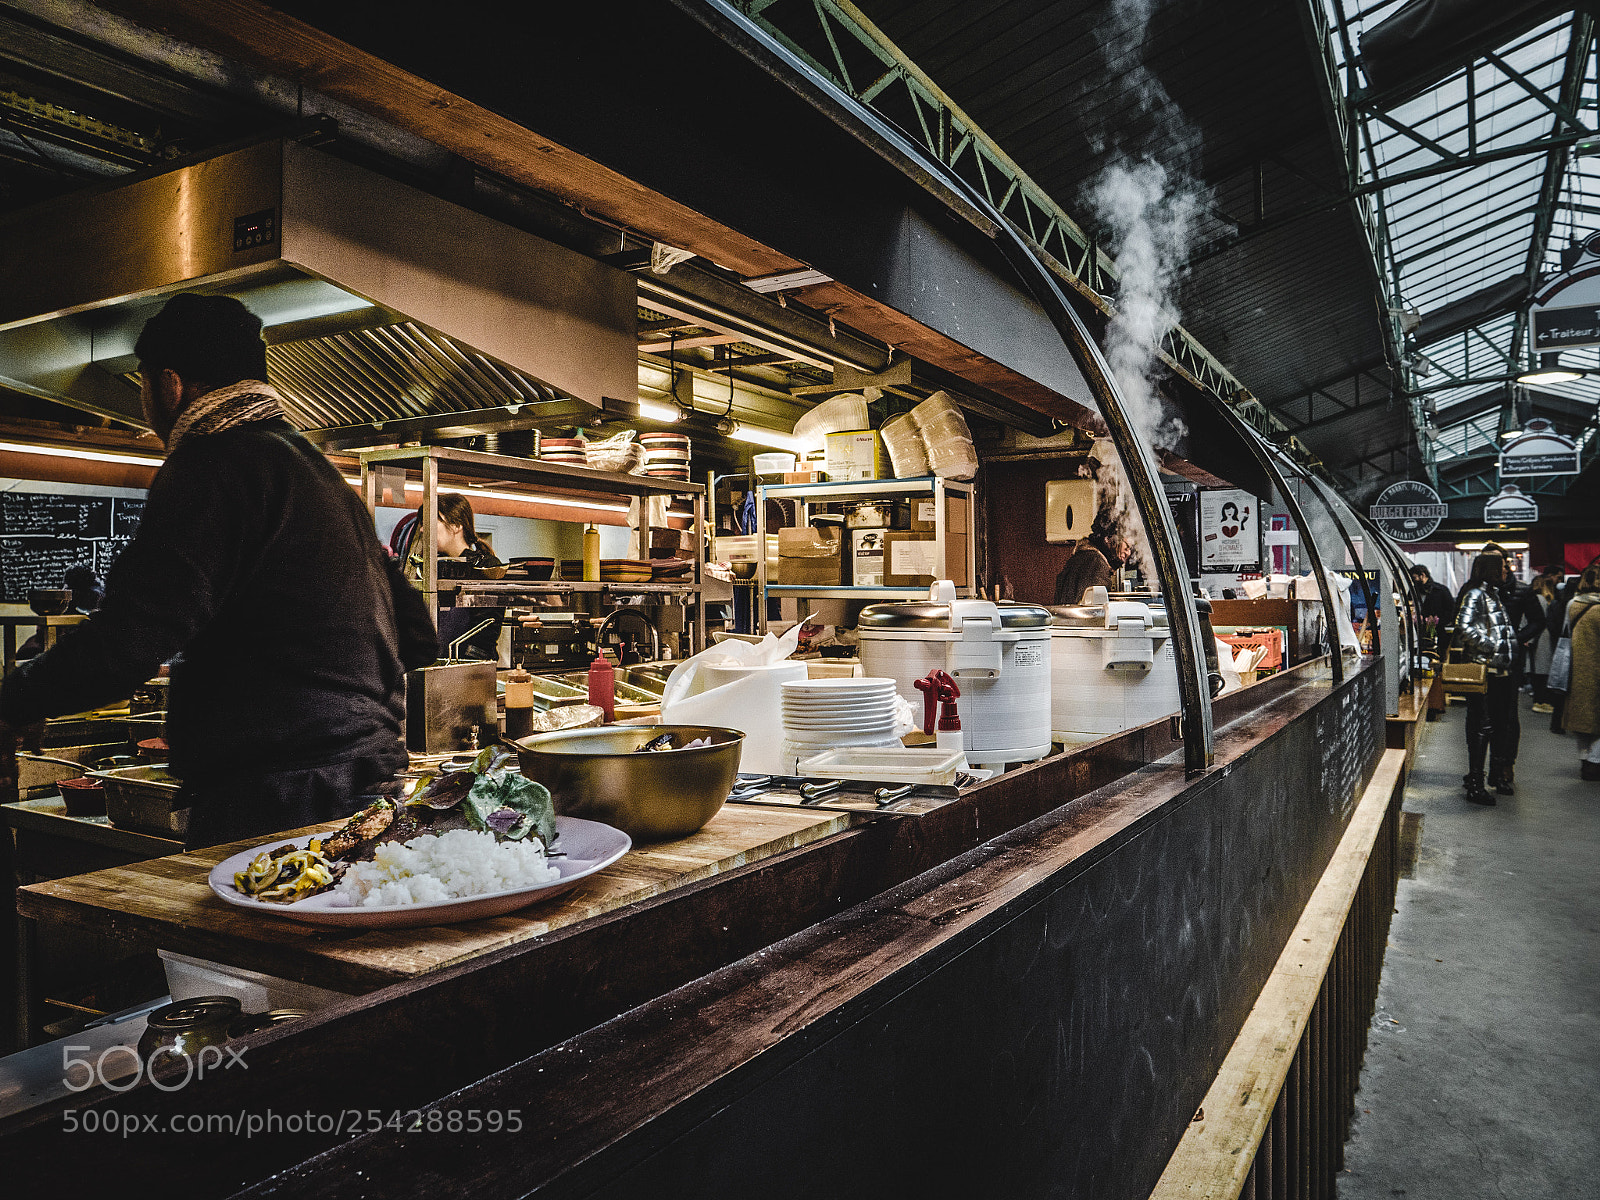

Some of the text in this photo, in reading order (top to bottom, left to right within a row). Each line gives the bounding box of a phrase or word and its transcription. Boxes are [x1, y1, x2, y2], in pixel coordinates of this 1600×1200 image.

[1549, 328, 1593, 338] Traiteur
[1411, 483, 1427, 495] PARIS
[1372, 506, 1446, 518] BURGER FERMIER
[1380, 520, 1437, 539] DES ENFANTS ROUGES
